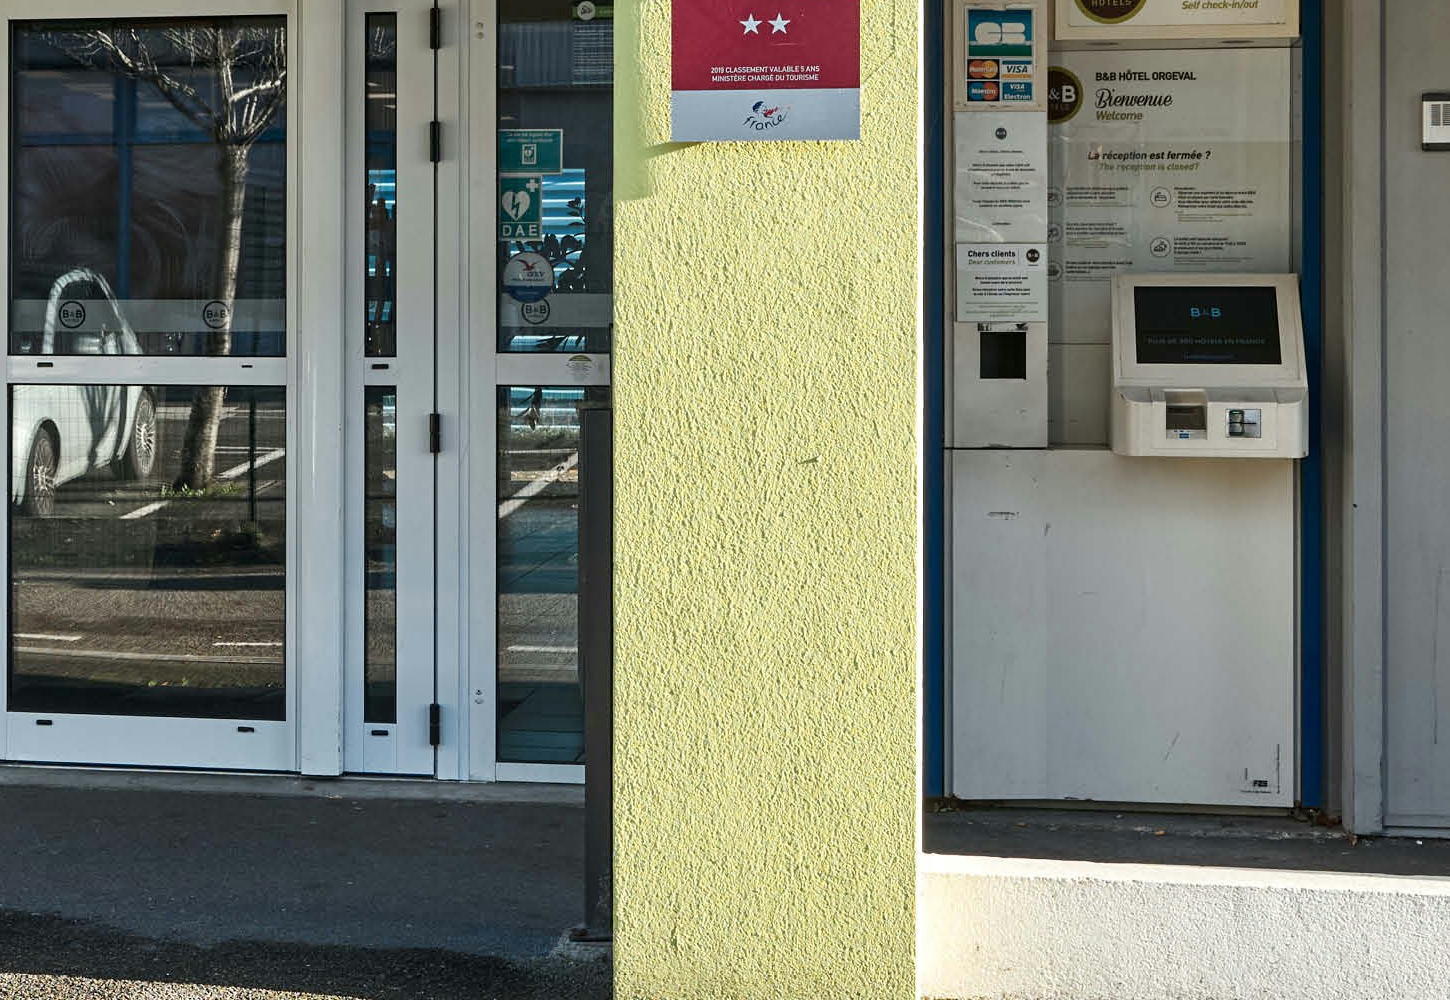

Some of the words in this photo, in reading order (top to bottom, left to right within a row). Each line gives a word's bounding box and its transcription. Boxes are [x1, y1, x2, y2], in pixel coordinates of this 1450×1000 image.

[1182, 0, 1200, 10] Self
[1201, 0, 1258, 10] check-in/out
[769, 65, 799, 73] VALABLE
[1006, 65, 1028, 73] VISA
[712, 74, 747, 82] MINISTÈRE
[1095, 72, 1117, 81] B&B
[1118, 69, 1150, 81] HÔTEL
[1152, 71, 1197, 81] ORGEVAL
[1095, 88, 1173, 109] Bienvenue
[1096, 110, 1143, 120] Welcome
[1088, 151, 1100, 160] La
[1102, 151, 1147, 162] réception
[1149, 152, 1165, 160] est
[1166, 150, 1202, 160] fermée
[1099, 162, 1114, 170] The
[1116, 163, 1157, 171] reception
[502, 224, 538, 236] DAE
[967, 250, 990, 258] Chers
[991, 250, 1016, 258] clients
